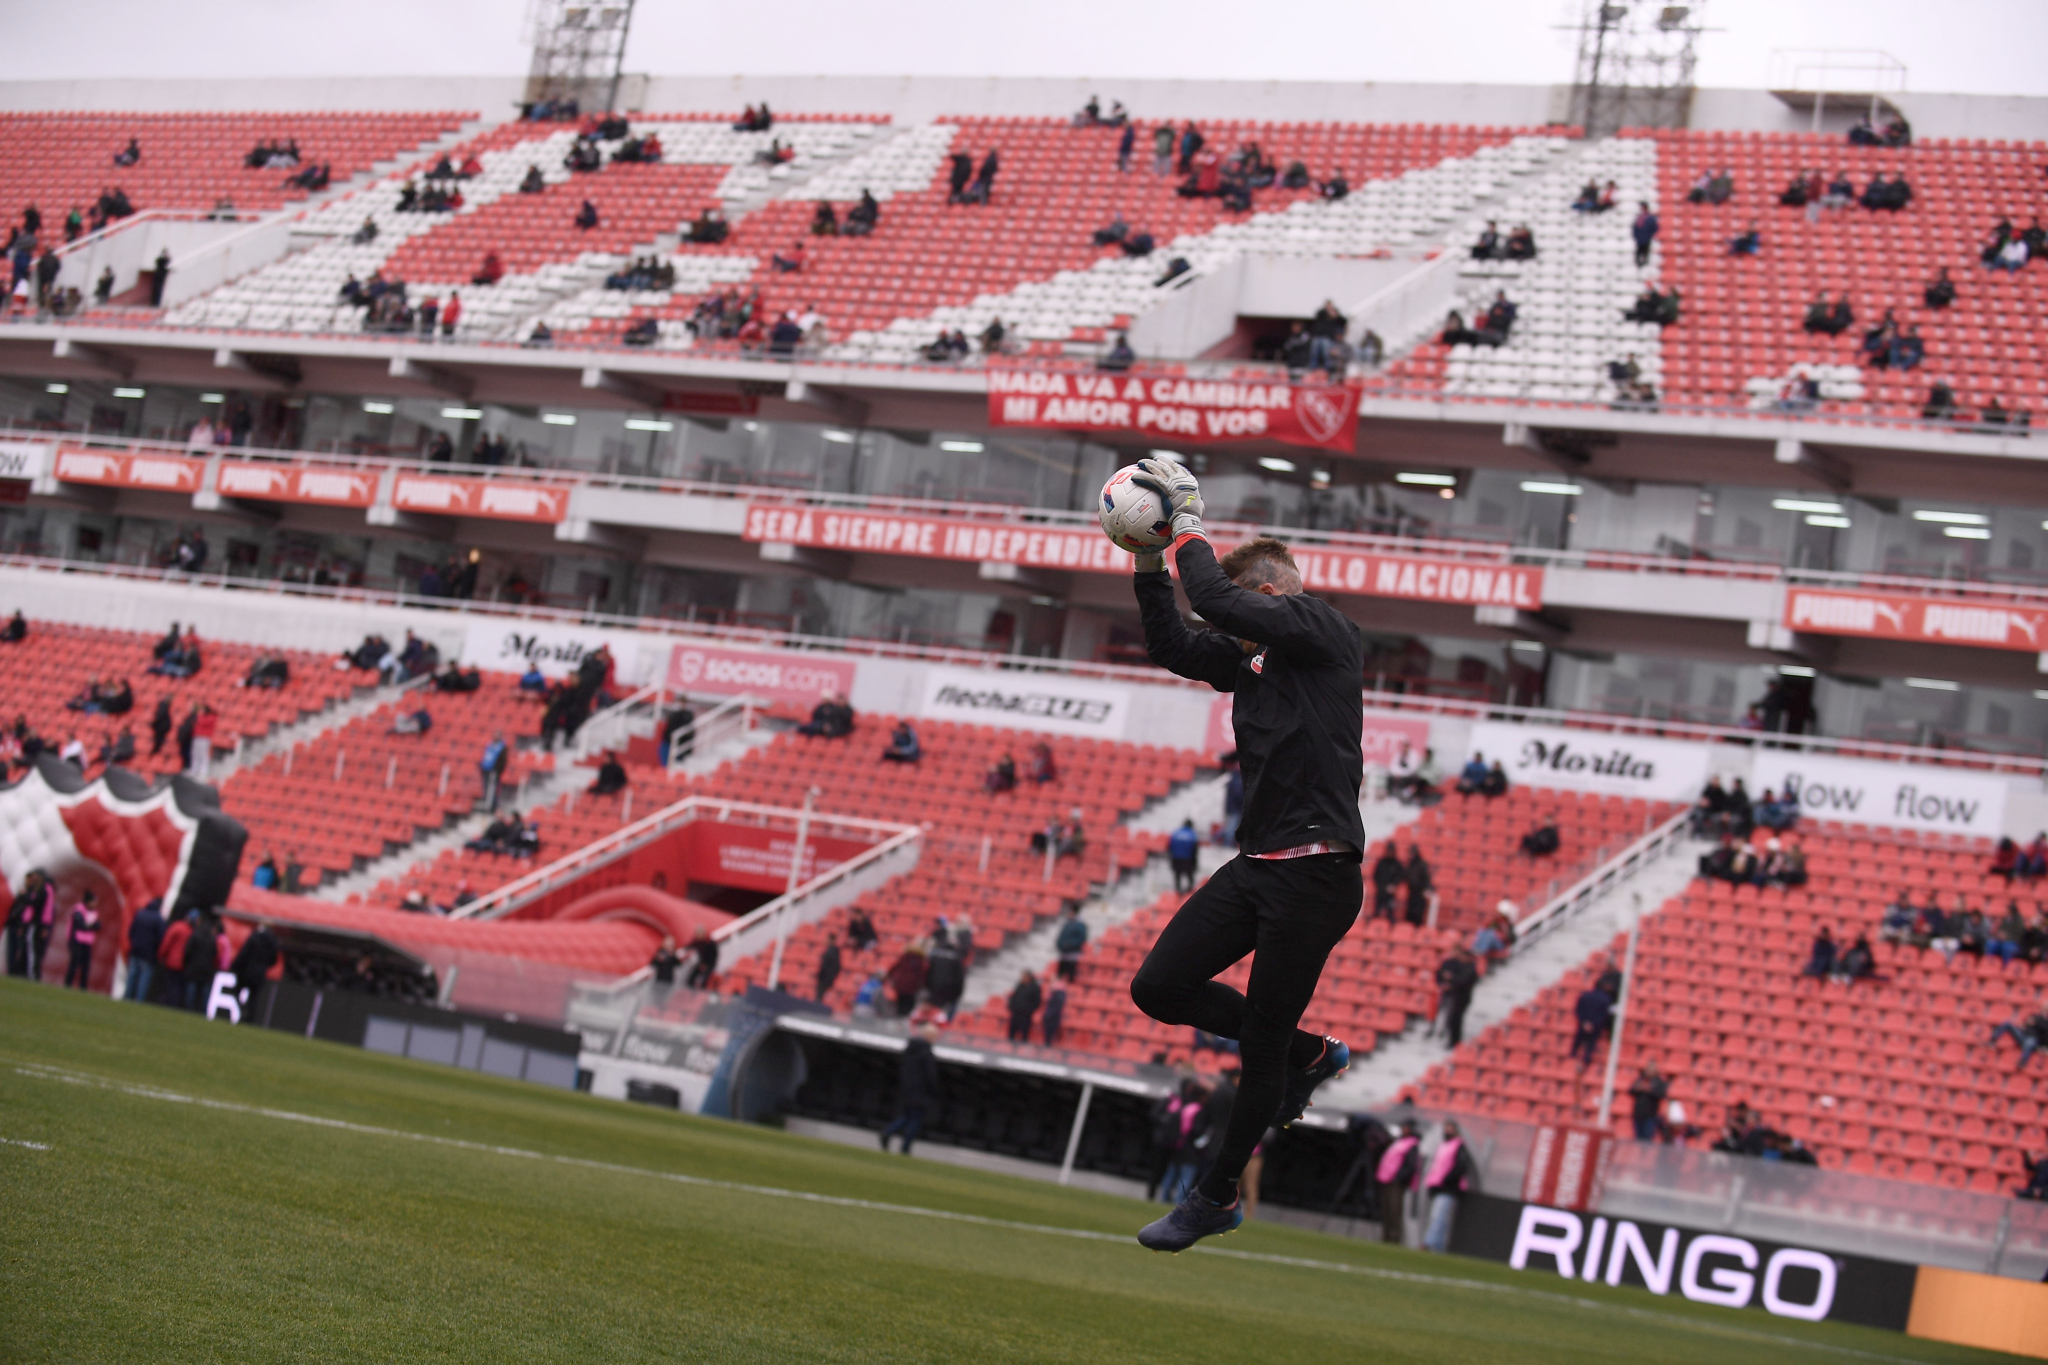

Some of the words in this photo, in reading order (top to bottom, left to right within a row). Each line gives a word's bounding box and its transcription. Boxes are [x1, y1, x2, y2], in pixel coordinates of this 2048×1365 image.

[989, 373, 1067, 395] NADA
[1075, 377, 1117, 399] VA
[1122, 378, 1146, 401] A
[1151, 380, 1293, 409] CAMBIAR
[1003, 396, 1038, 422] MI
[1042, 398, 1132, 427] AMOR
[1136, 405, 1200, 434] POR
[1205, 411, 1269, 436] VOS
[822, 515, 937, 553] SIEMPRE
[944, 526, 1133, 570] INDEPENDIEN
[1295, 554, 1367, 589] ULLO
[1376, 561, 1532, 604] NACIONAL
[1791, 594, 1876, 632] PUMA
[1922, 604, 2010, 643] PUMA
[499, 633, 590, 662] Morit
[1518, 739, 1655, 780] Morita
[1894, 783, 1980, 824] flow
[1508, 1204, 1838, 1322] RINGO
